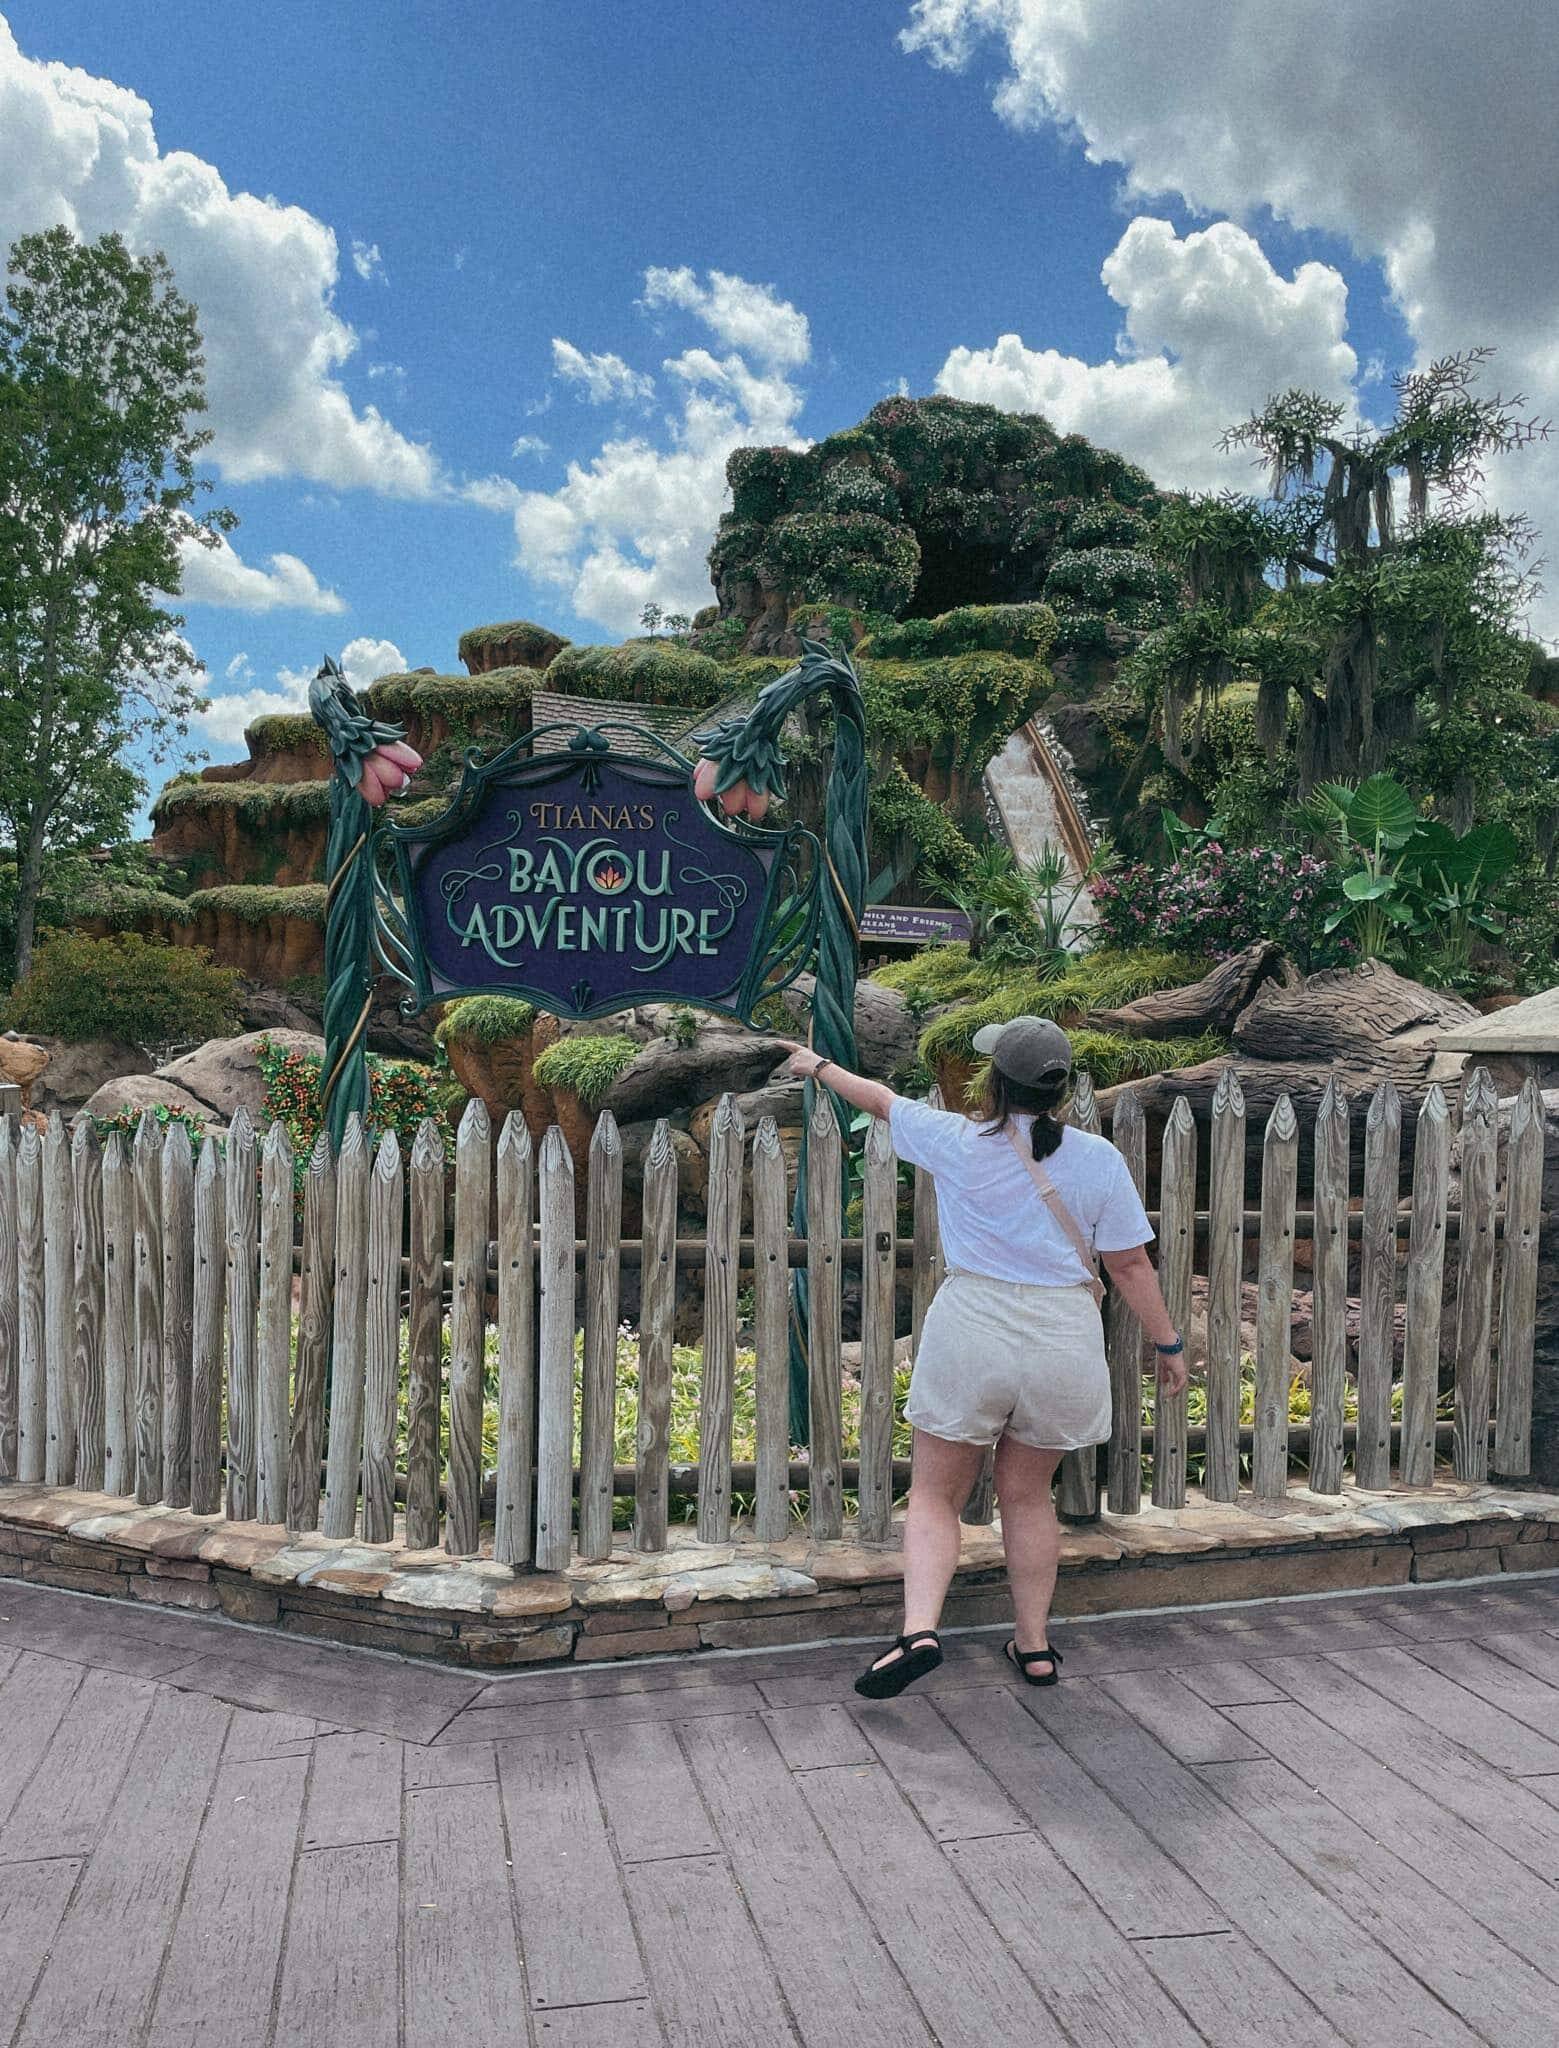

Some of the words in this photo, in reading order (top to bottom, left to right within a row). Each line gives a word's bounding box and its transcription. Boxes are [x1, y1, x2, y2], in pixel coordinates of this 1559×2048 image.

[529, 802, 655, 830] TIANA'S
[506, 836, 674, 896] BAYOU
[460, 896, 720, 972] ADVENTURE
[860, 920, 896, 929] RLEANS
